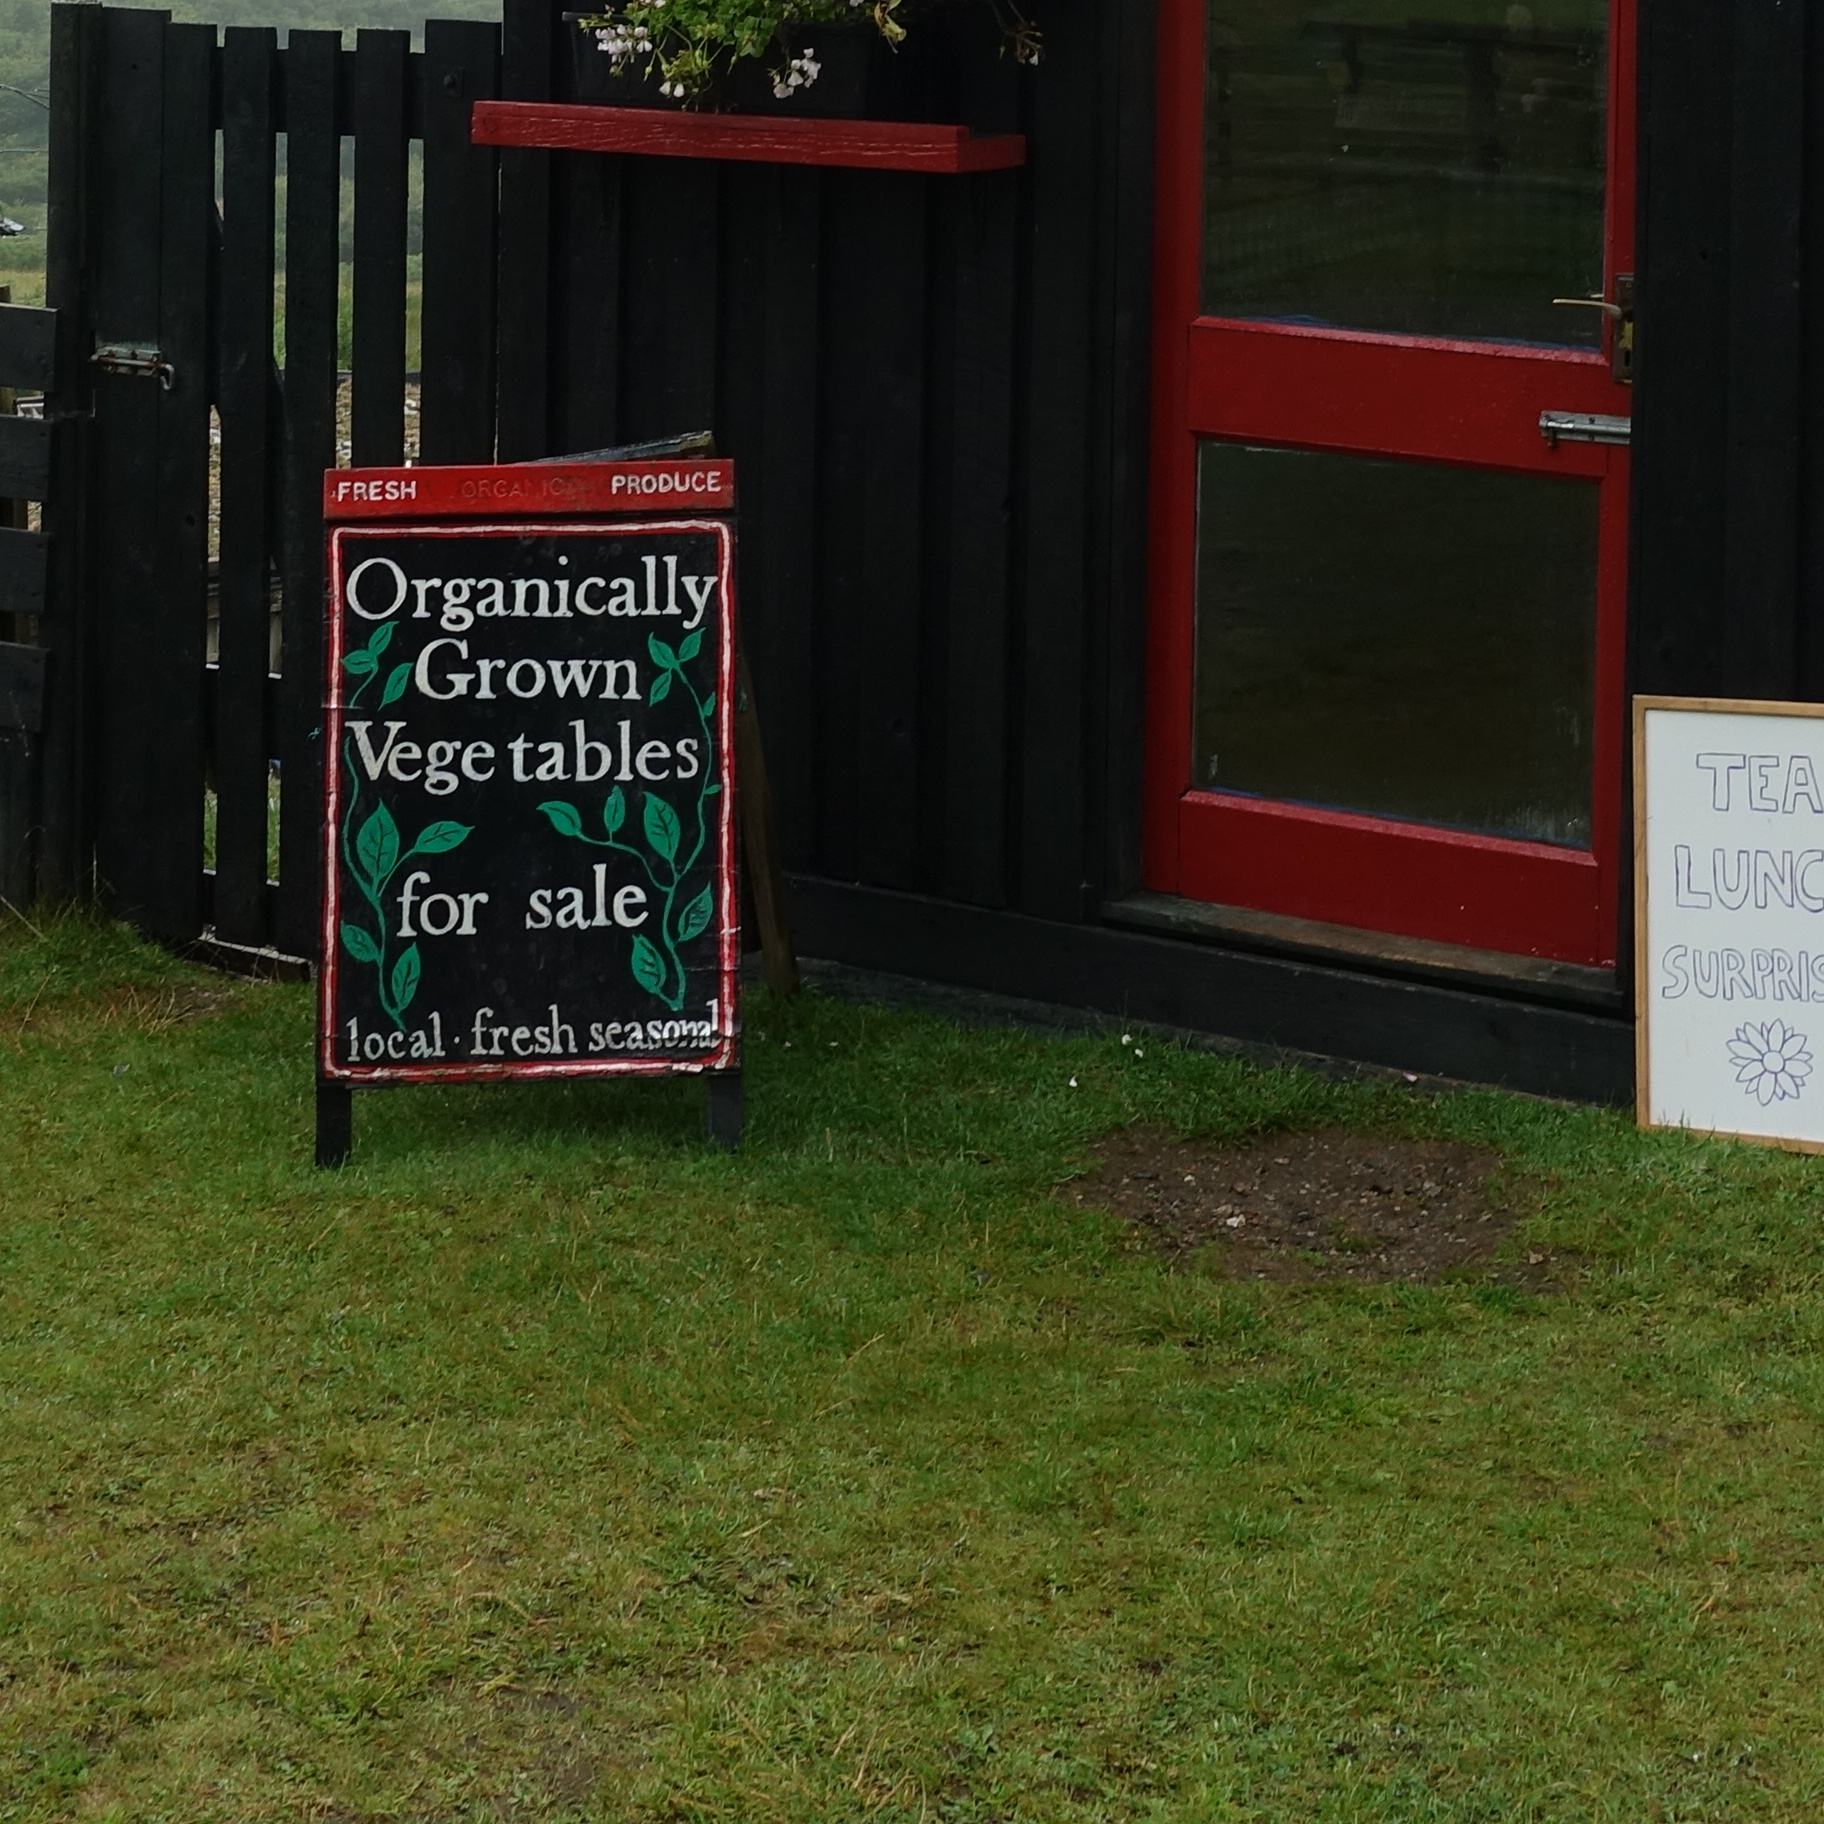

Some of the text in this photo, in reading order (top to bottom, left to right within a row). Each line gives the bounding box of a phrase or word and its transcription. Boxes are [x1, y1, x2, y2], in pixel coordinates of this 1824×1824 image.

[337, 480, 417, 502] FRESH
[611, 471, 722, 495] PRODUCE
[346, 555, 719, 632] Organically
[414, 638, 642, 700] Grown
[1695, 752, 1824, 814] TEA
[396, 863, 649, 937] for sale
[346, 998, 721, 1062] local fresh seasonal
